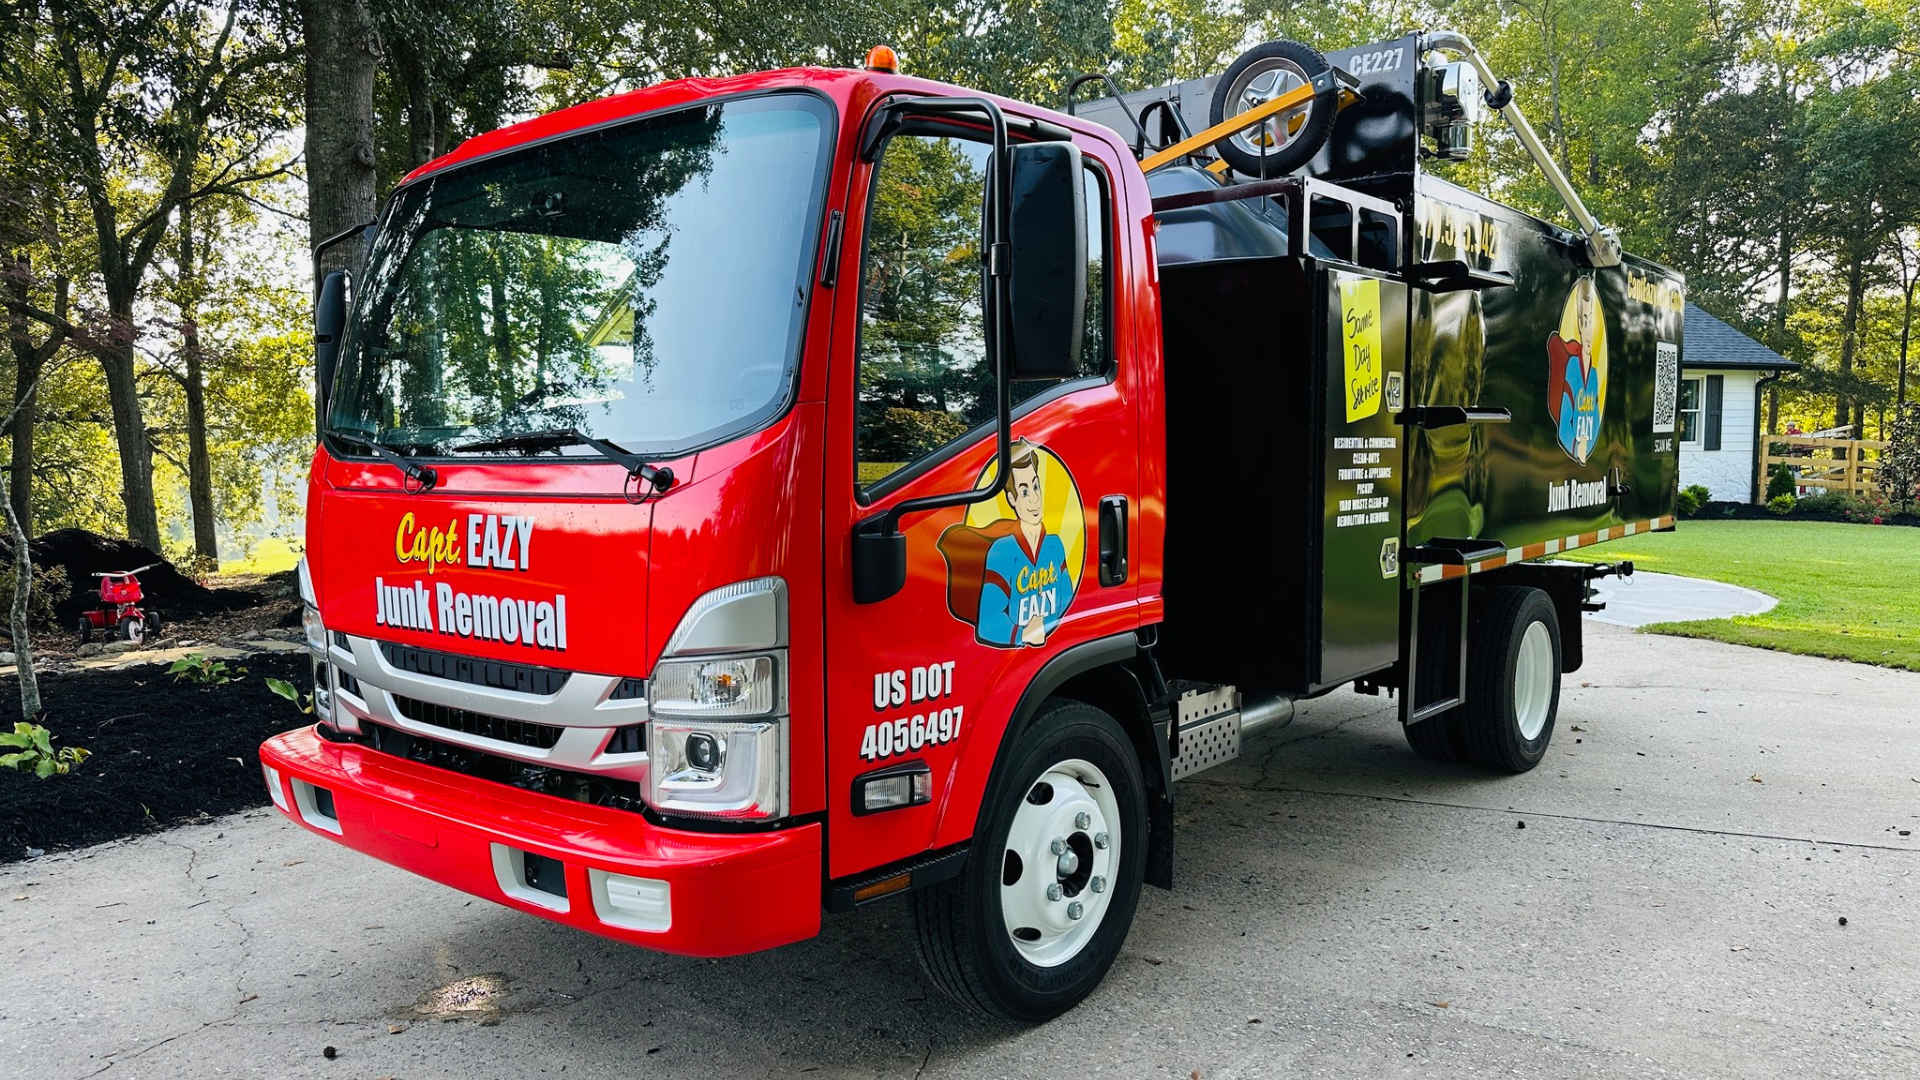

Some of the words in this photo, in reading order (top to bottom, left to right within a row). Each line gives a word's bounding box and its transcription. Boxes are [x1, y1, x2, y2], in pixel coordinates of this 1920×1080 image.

[1349, 47, 1404, 76] CE227
[1346, 307, 1374, 339] Same
[1353, 343, 1372, 373] Day
[1351, 377, 1380, 411] Service
[1333, 437, 1364, 449] RESIDENTIAL
[1364, 438, 1369, 449] &
[1369, 437, 1397, 449] COMMERCIAL
[1576, 415, 1594, 441] EAZY
[1352, 452, 1380, 465] CLEAN-OUTS
[1654, 440, 1664, 452] SCAN
[1665, 438, 1672, 451] ME
[1338, 468, 1364, 481] FURNITURE
[1368, 467, 1392, 479] APPLIANCE
[1356, 483, 1374, 495] PICKUP
[1339, 499, 1352, 512] YARD
[1352, 498, 1368, 511] WASTE
[1368, 496, 1389, 509] CLEAN-UP
[1547, 479, 1570, 513] Junk
[1570, 475, 1607, 508] Removal
[1336, 514, 1365, 528] DEMOLITION
[1369, 511, 1390, 524] REMOVAL
[395, 511, 461, 575] Capt.
[466, 513, 536, 572] EAZY
[1016, 561, 1059, 596] Capt.
[375, 576, 433, 632] Junk
[435, 582, 567, 651] Removal
[1018, 587, 1057, 628] EAZY
[873, 669, 907, 711] US
[911, 660, 956, 704] DOT
[859, 704, 965, 763] 4056497
